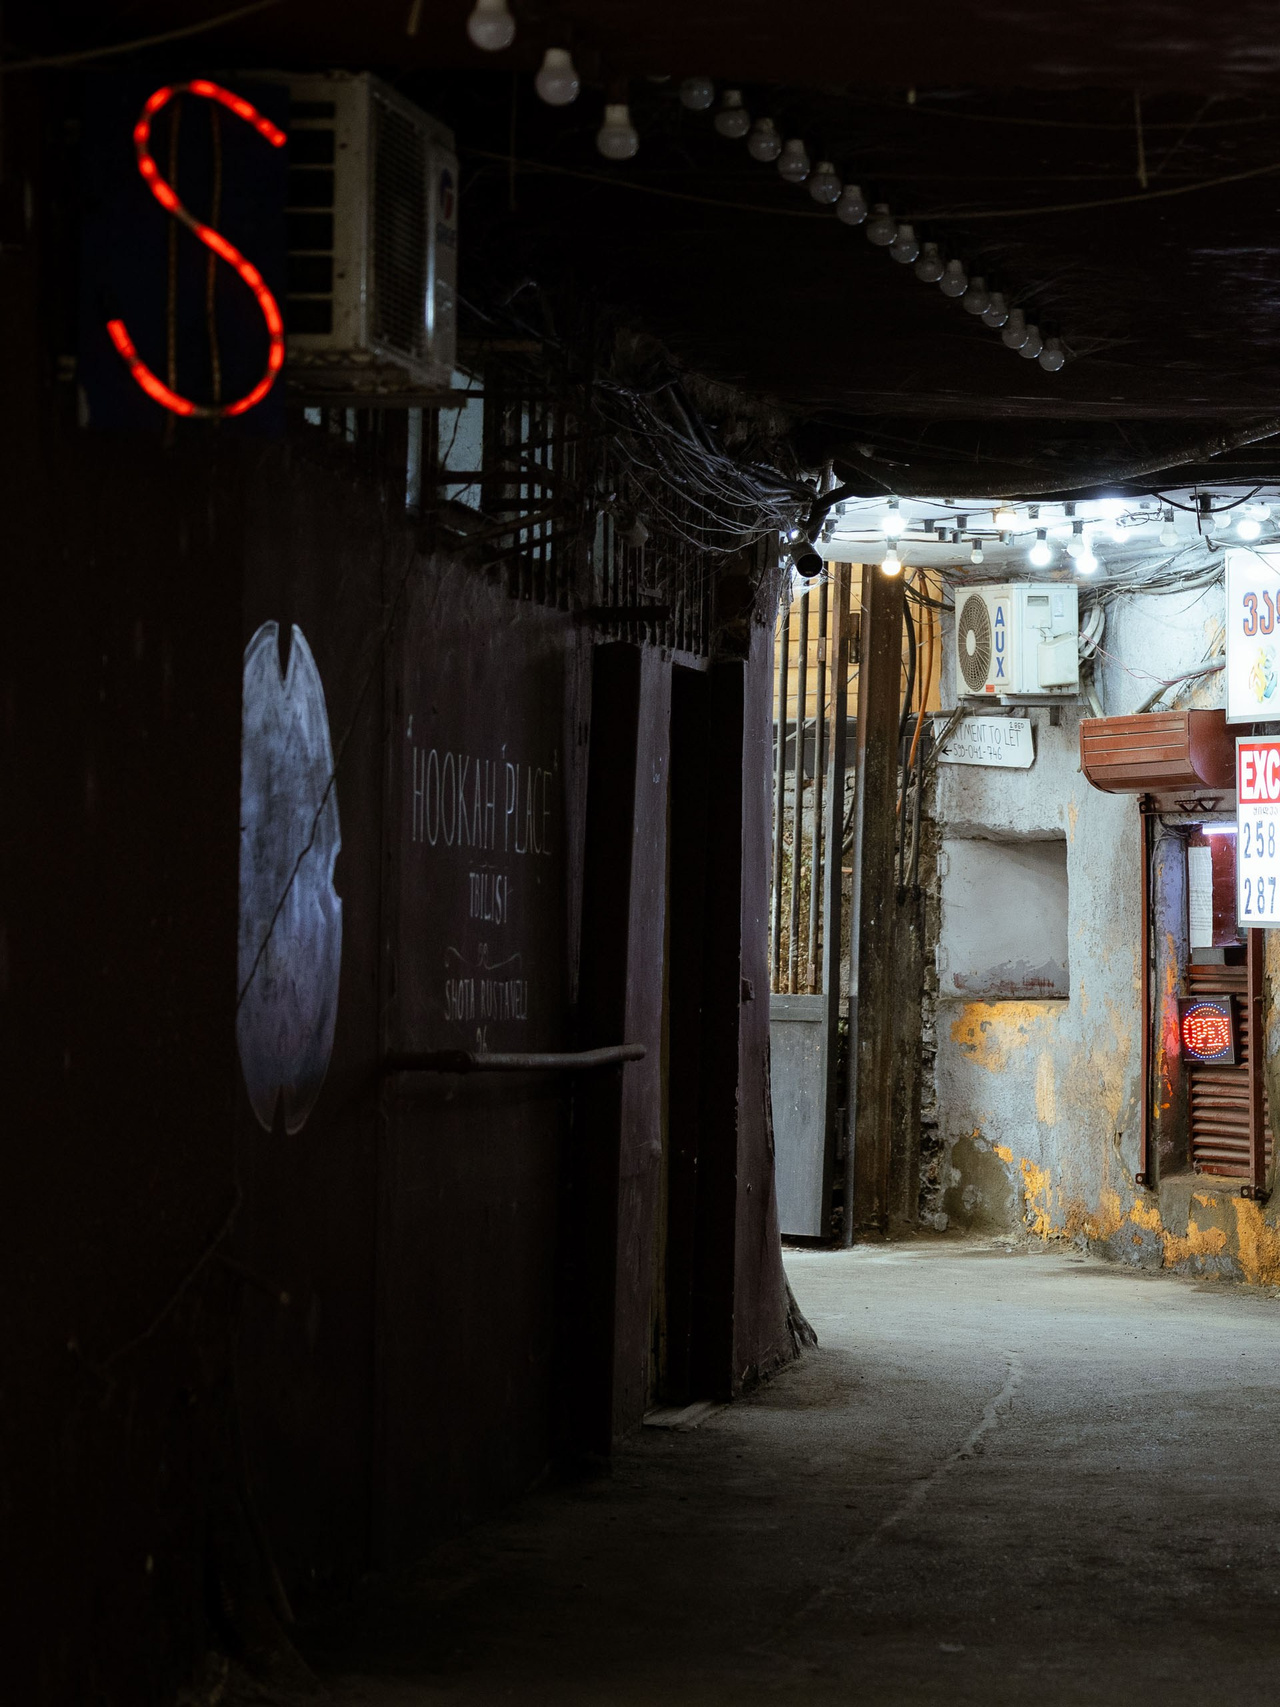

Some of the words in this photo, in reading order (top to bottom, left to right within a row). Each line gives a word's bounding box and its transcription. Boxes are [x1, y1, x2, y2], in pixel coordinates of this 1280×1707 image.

[994, 606, 1005, 678] AUX
[988, 725, 1002, 744] TO
[1004, 728, 1021, 747] LET
[412, 746, 496, 850] HOOKAH
[504, 762, 552, 855] PLACE
[1183, 1016, 1229, 1047] OPEN
